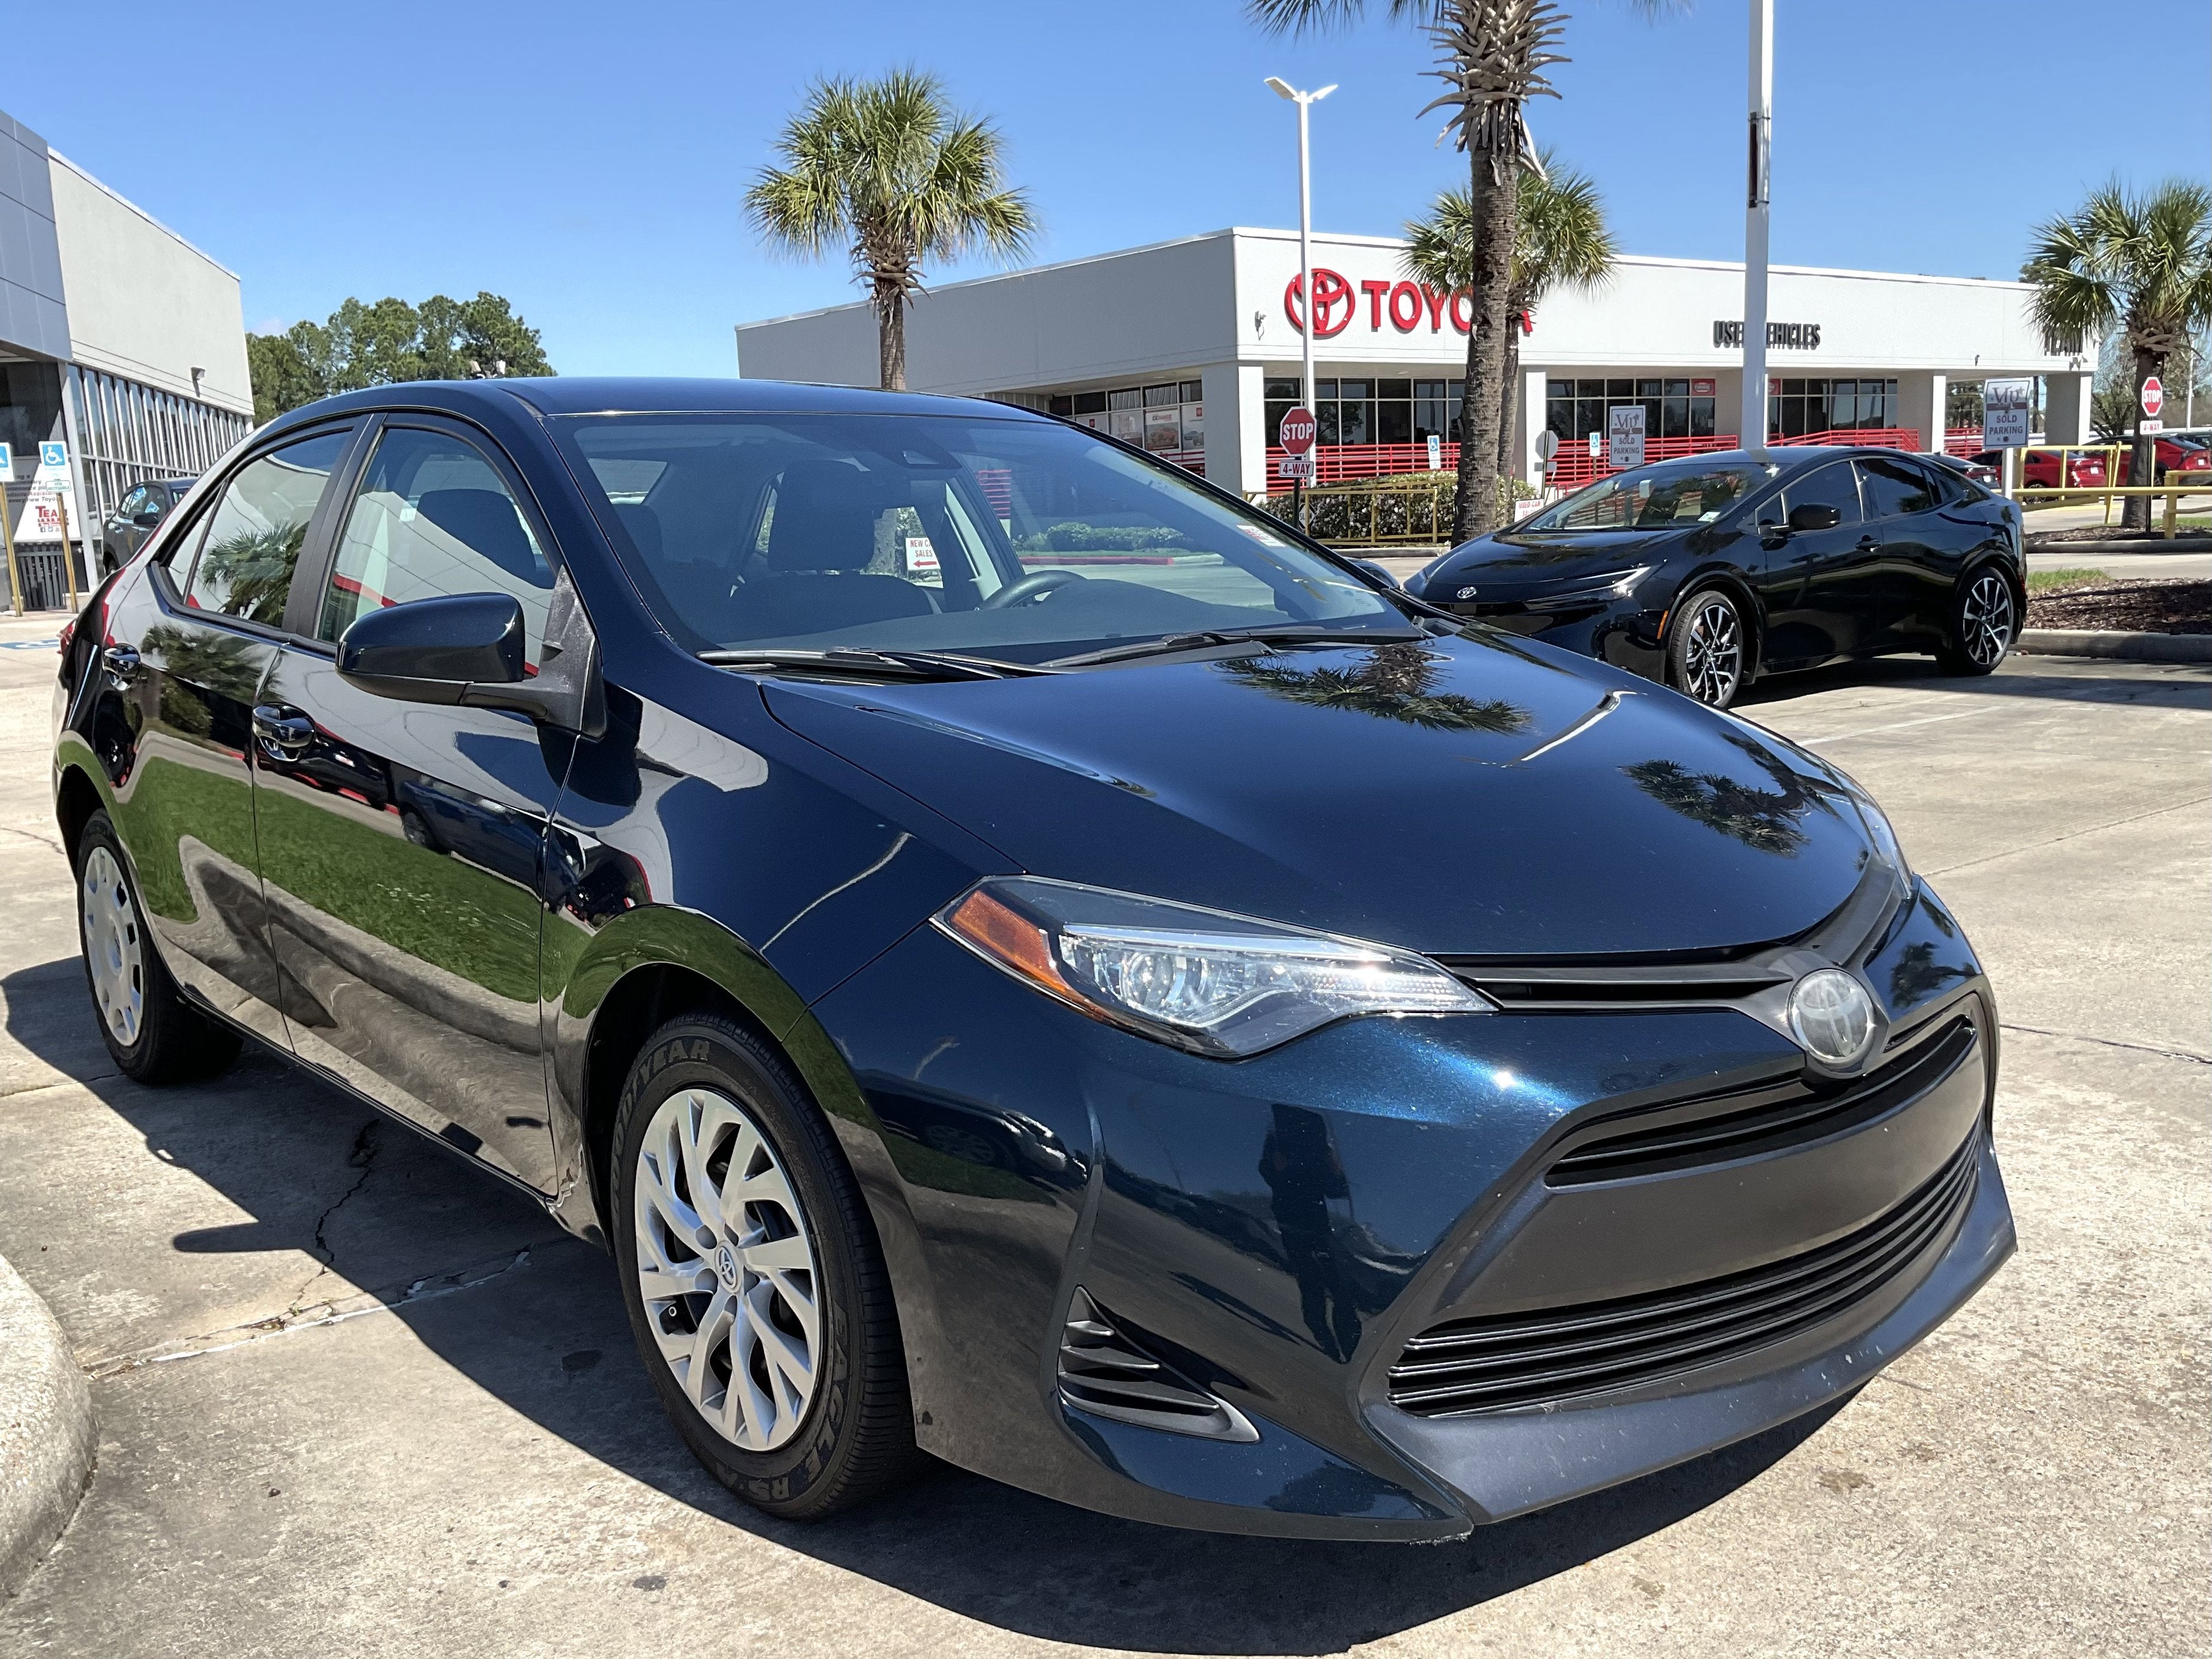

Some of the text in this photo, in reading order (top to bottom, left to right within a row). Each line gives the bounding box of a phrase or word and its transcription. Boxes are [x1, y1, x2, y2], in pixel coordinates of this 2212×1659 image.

[1713, 321, 1820, 350] USE EHICLES
[2144, 389, 2161, 403] STOP
[1996, 414, 2017, 423] SOLD
[1283, 423, 1313, 441] STOP
[1989, 426, 2023, 435] PARKING
[1283, 463, 1310, 474] 4-WAY
[910, 539, 923, 547] NEW
[915, 549, 933, 558] SALES
[805, 1299, 849, 1484] EAGLE
